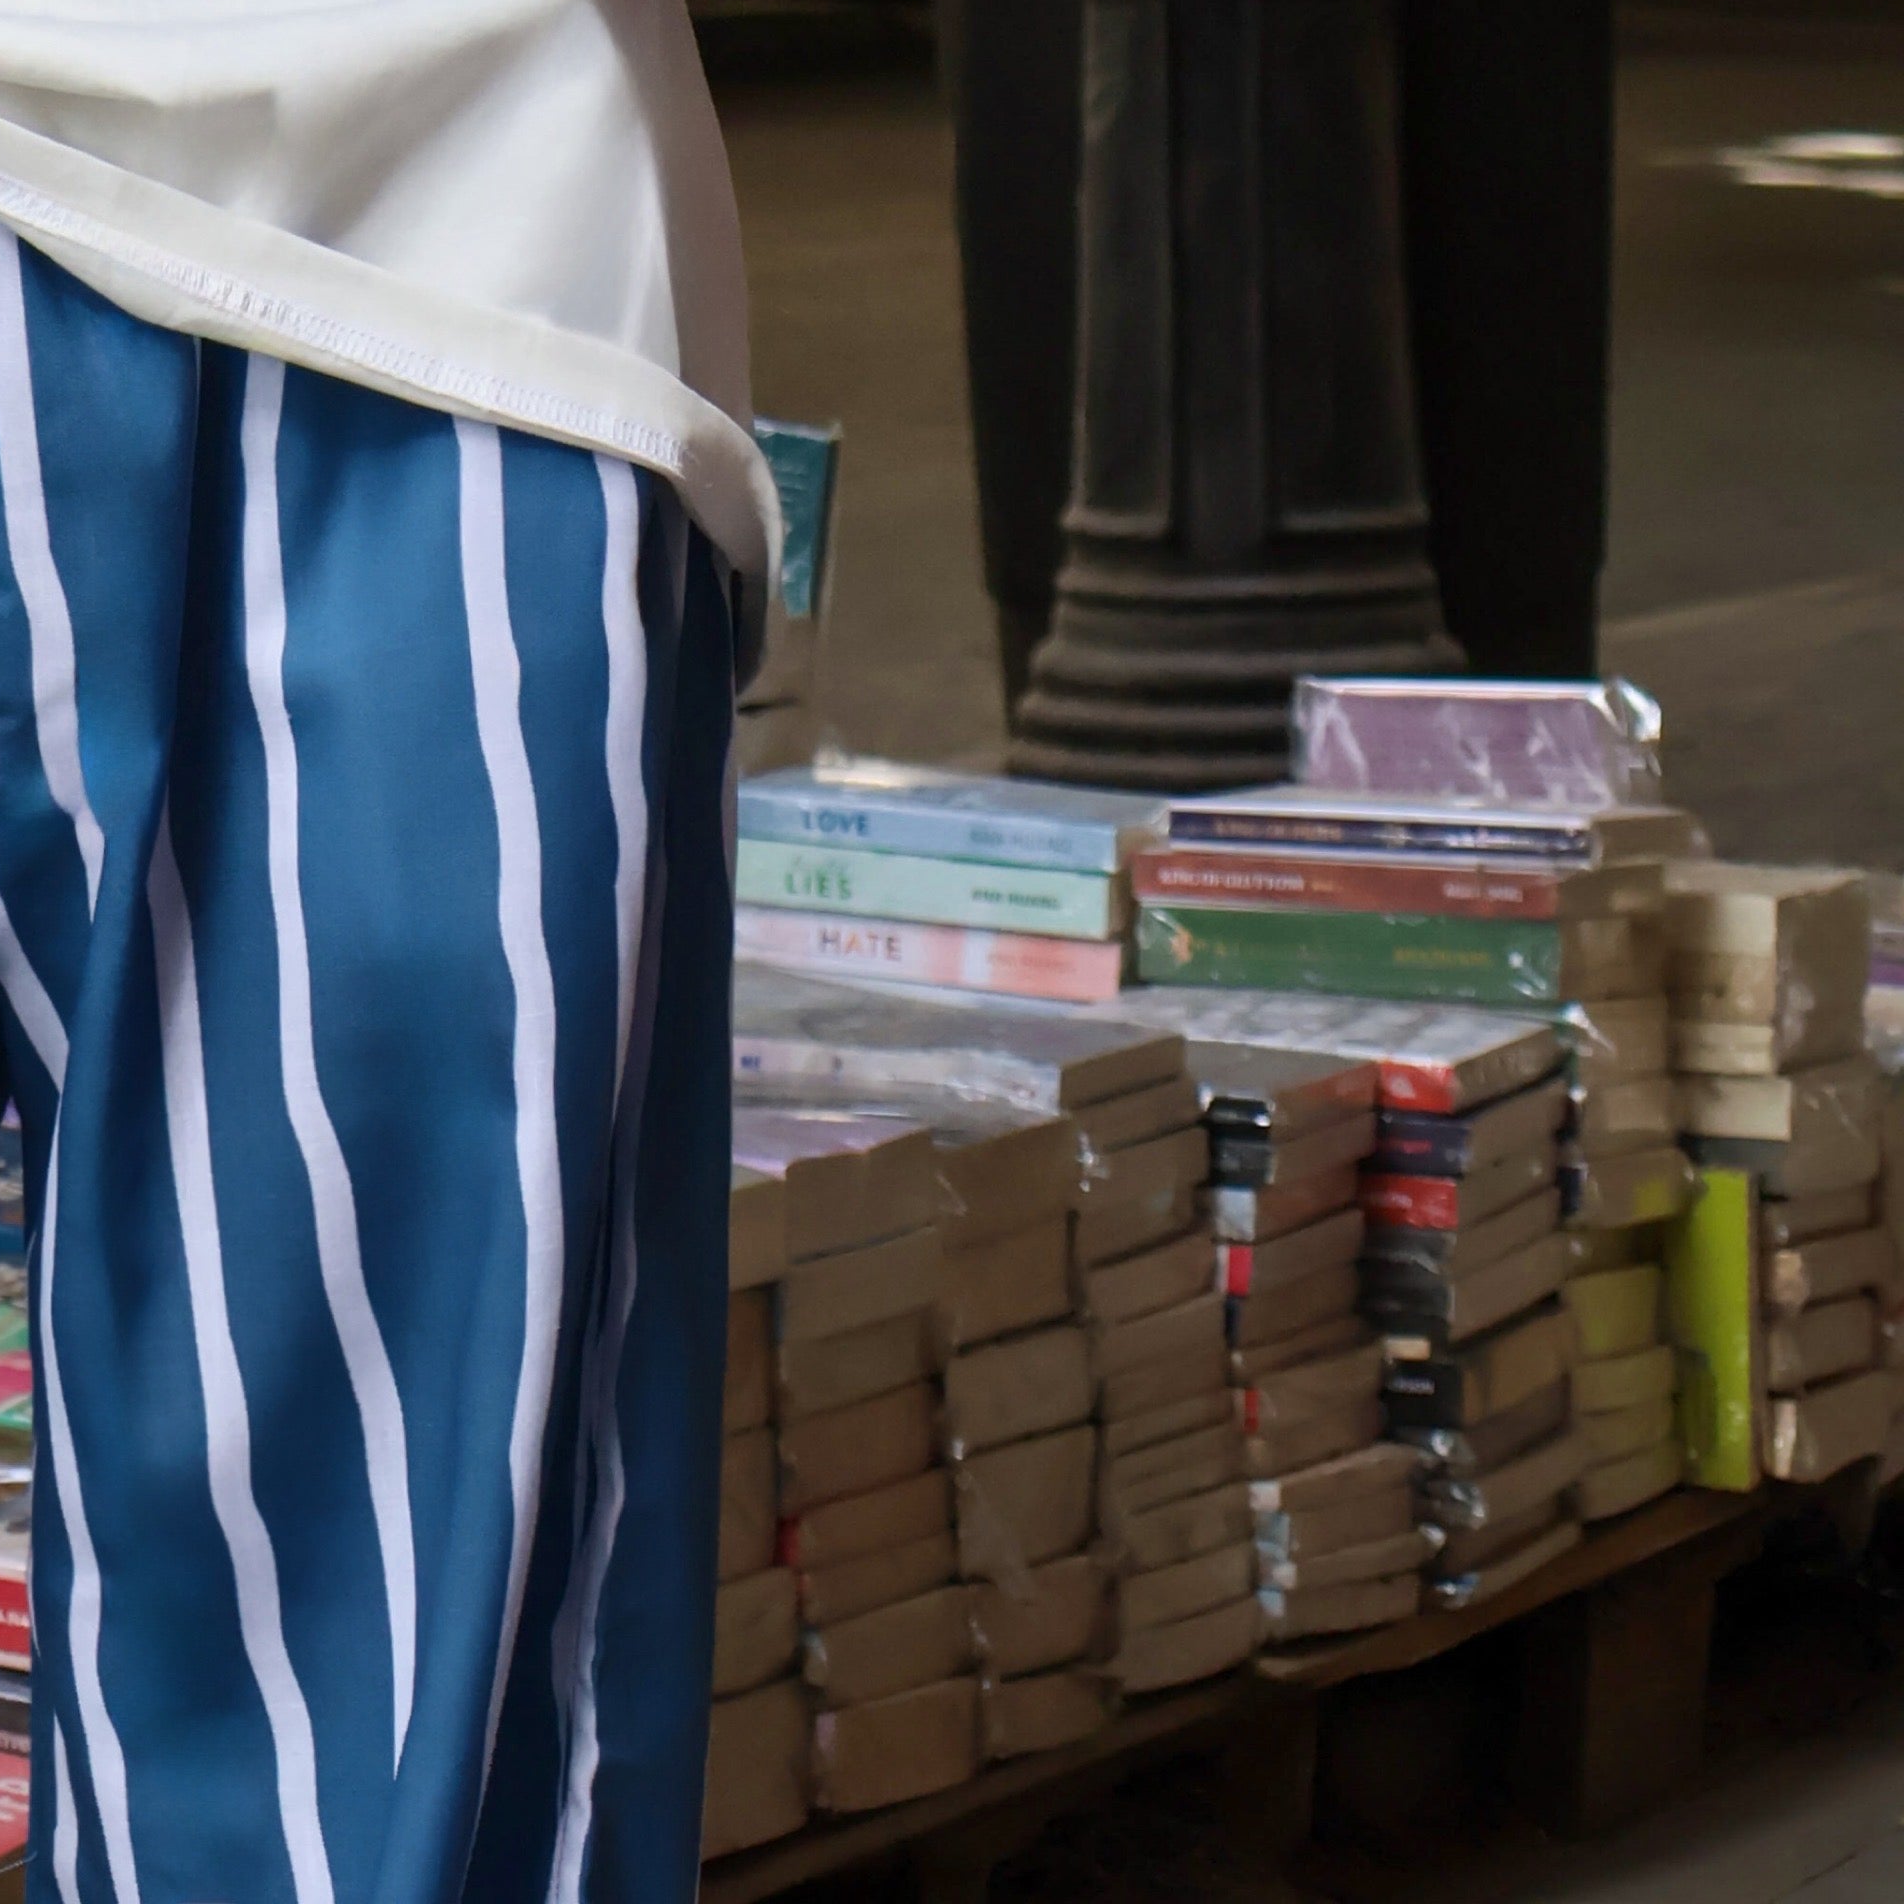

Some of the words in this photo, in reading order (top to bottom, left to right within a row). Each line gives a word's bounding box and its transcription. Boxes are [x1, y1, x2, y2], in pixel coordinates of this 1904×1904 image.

[800, 809, 873, 837] LOVE
[783, 868, 853, 902] LIES
[817, 925, 904, 962] HATE
